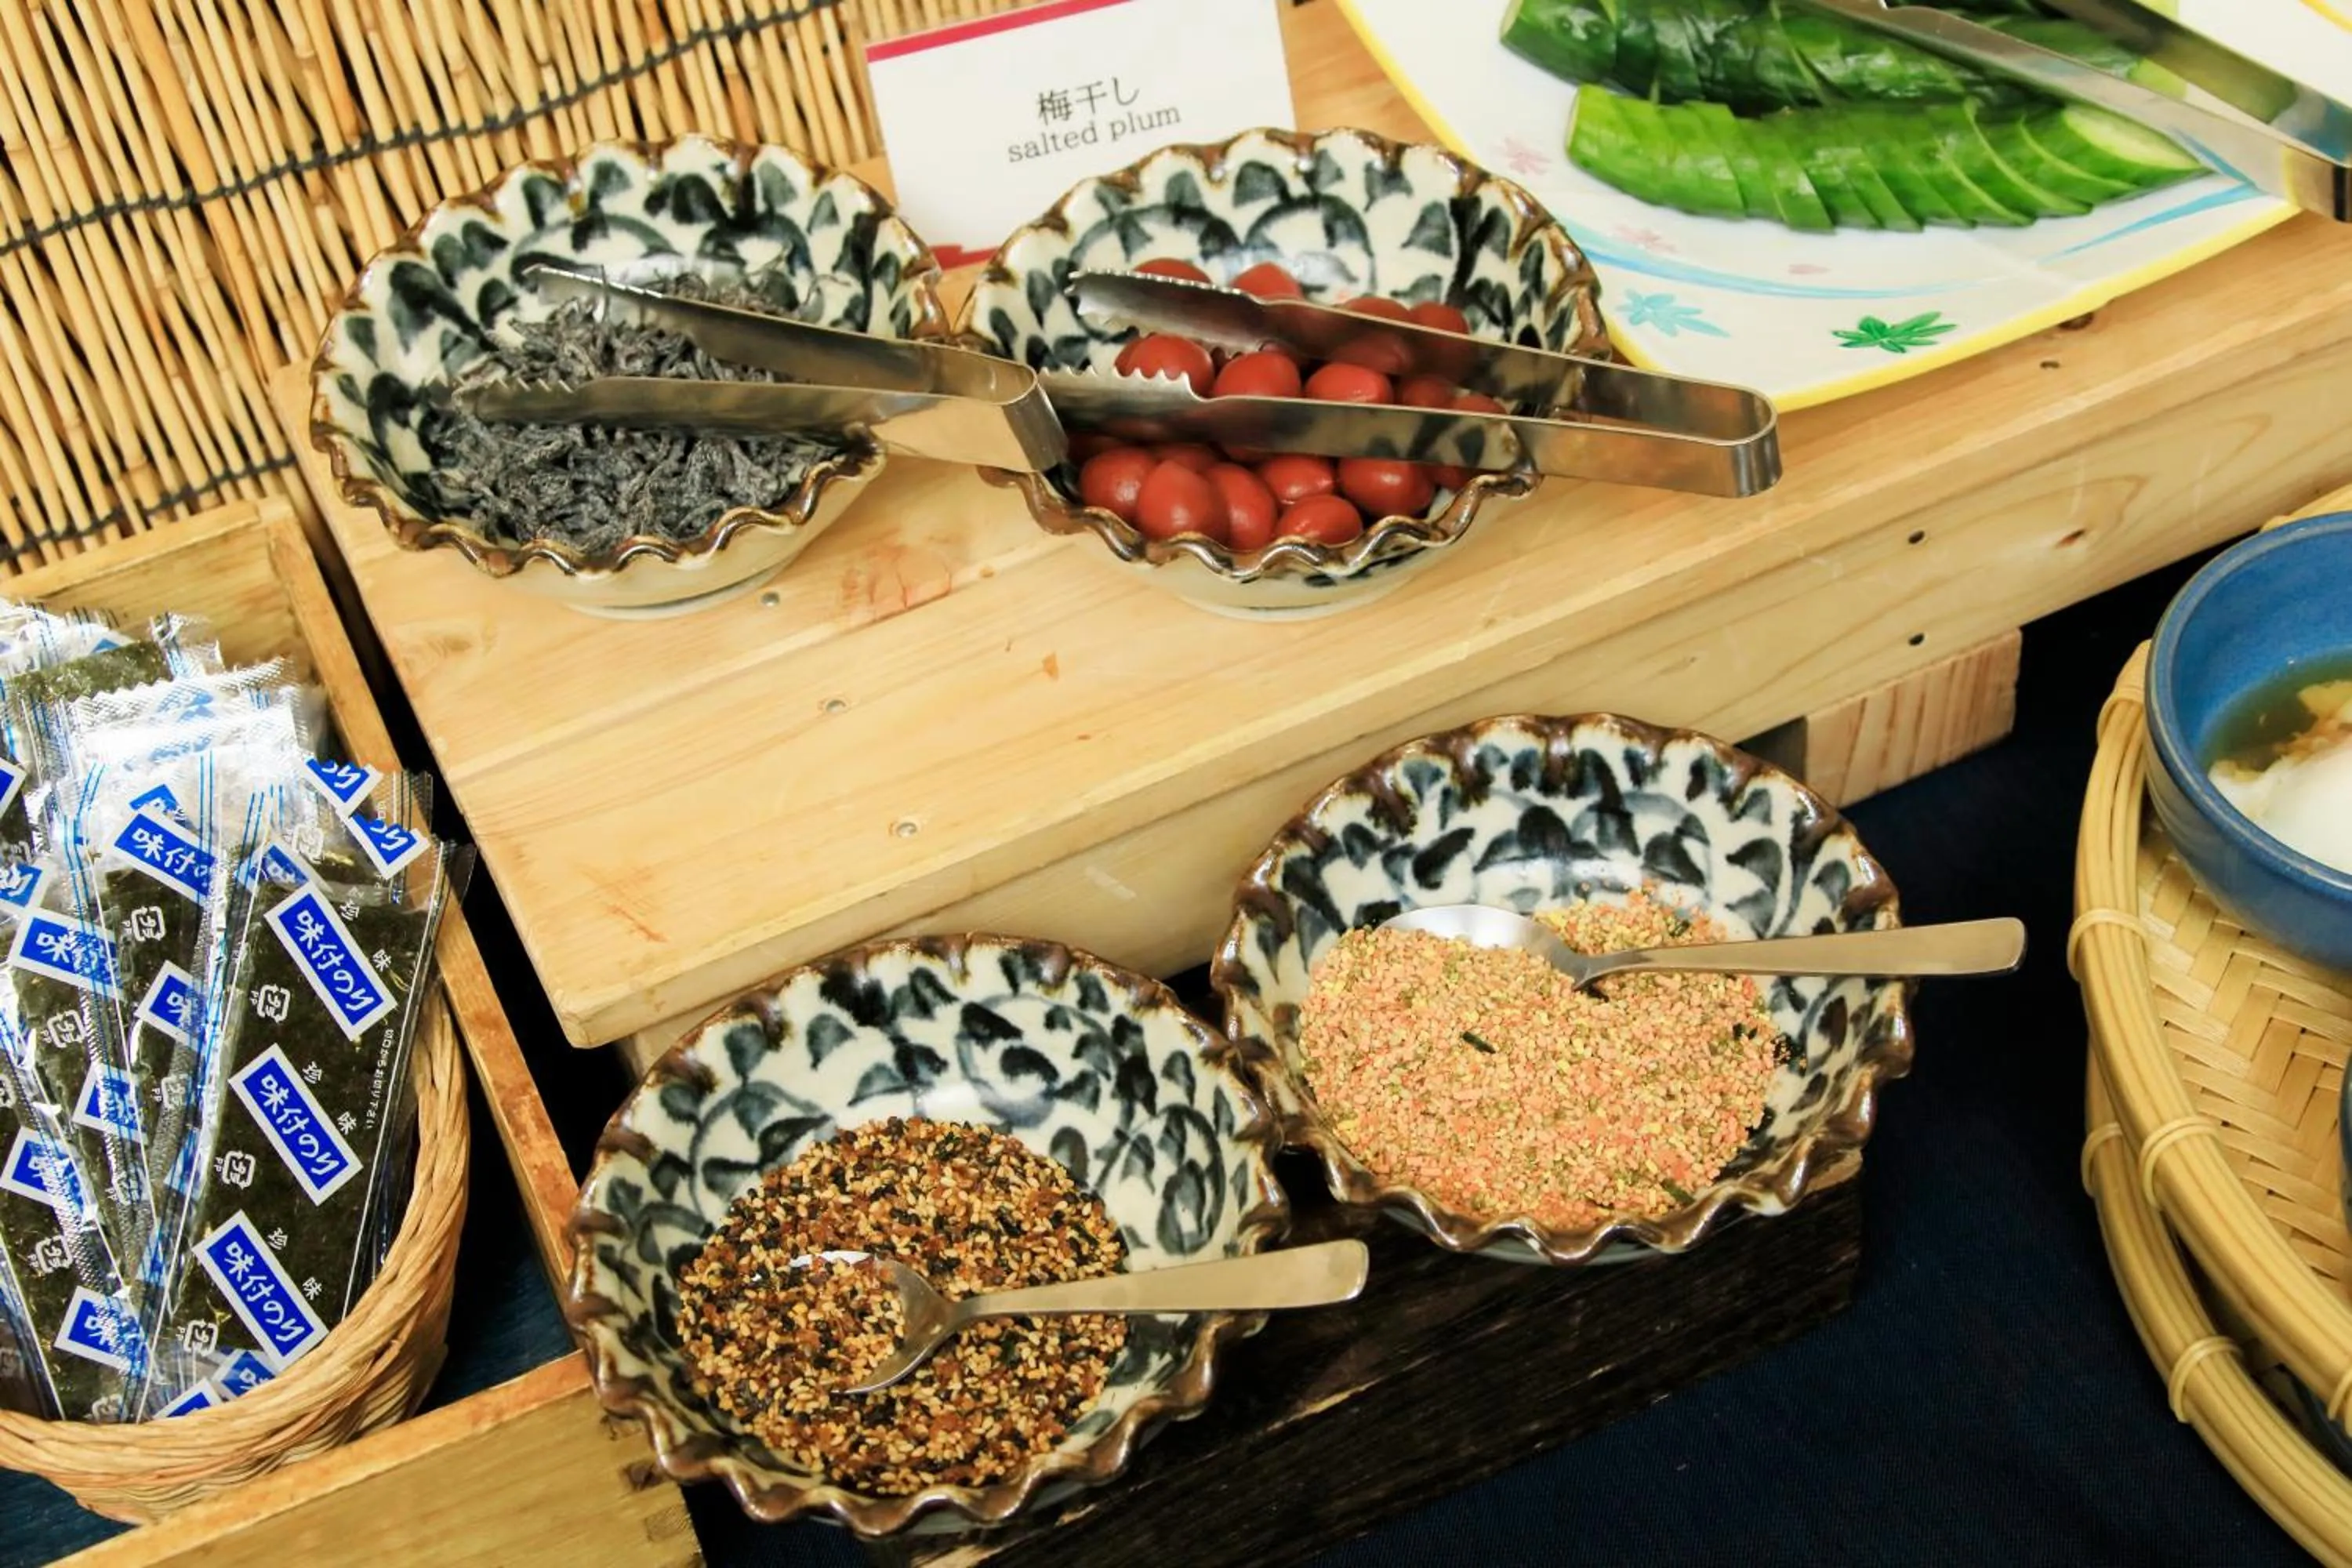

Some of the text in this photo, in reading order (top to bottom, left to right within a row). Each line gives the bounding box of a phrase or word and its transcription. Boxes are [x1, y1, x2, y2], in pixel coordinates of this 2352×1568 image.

[1007, 105, 1182, 163] salted plum
[1036, 76, 1140, 125] 梅干し
[295, 909, 375, 1011] 味付のり
[260, 1073, 339, 1175] 味付のり
[224, 1241, 305, 1341] 味付のり
